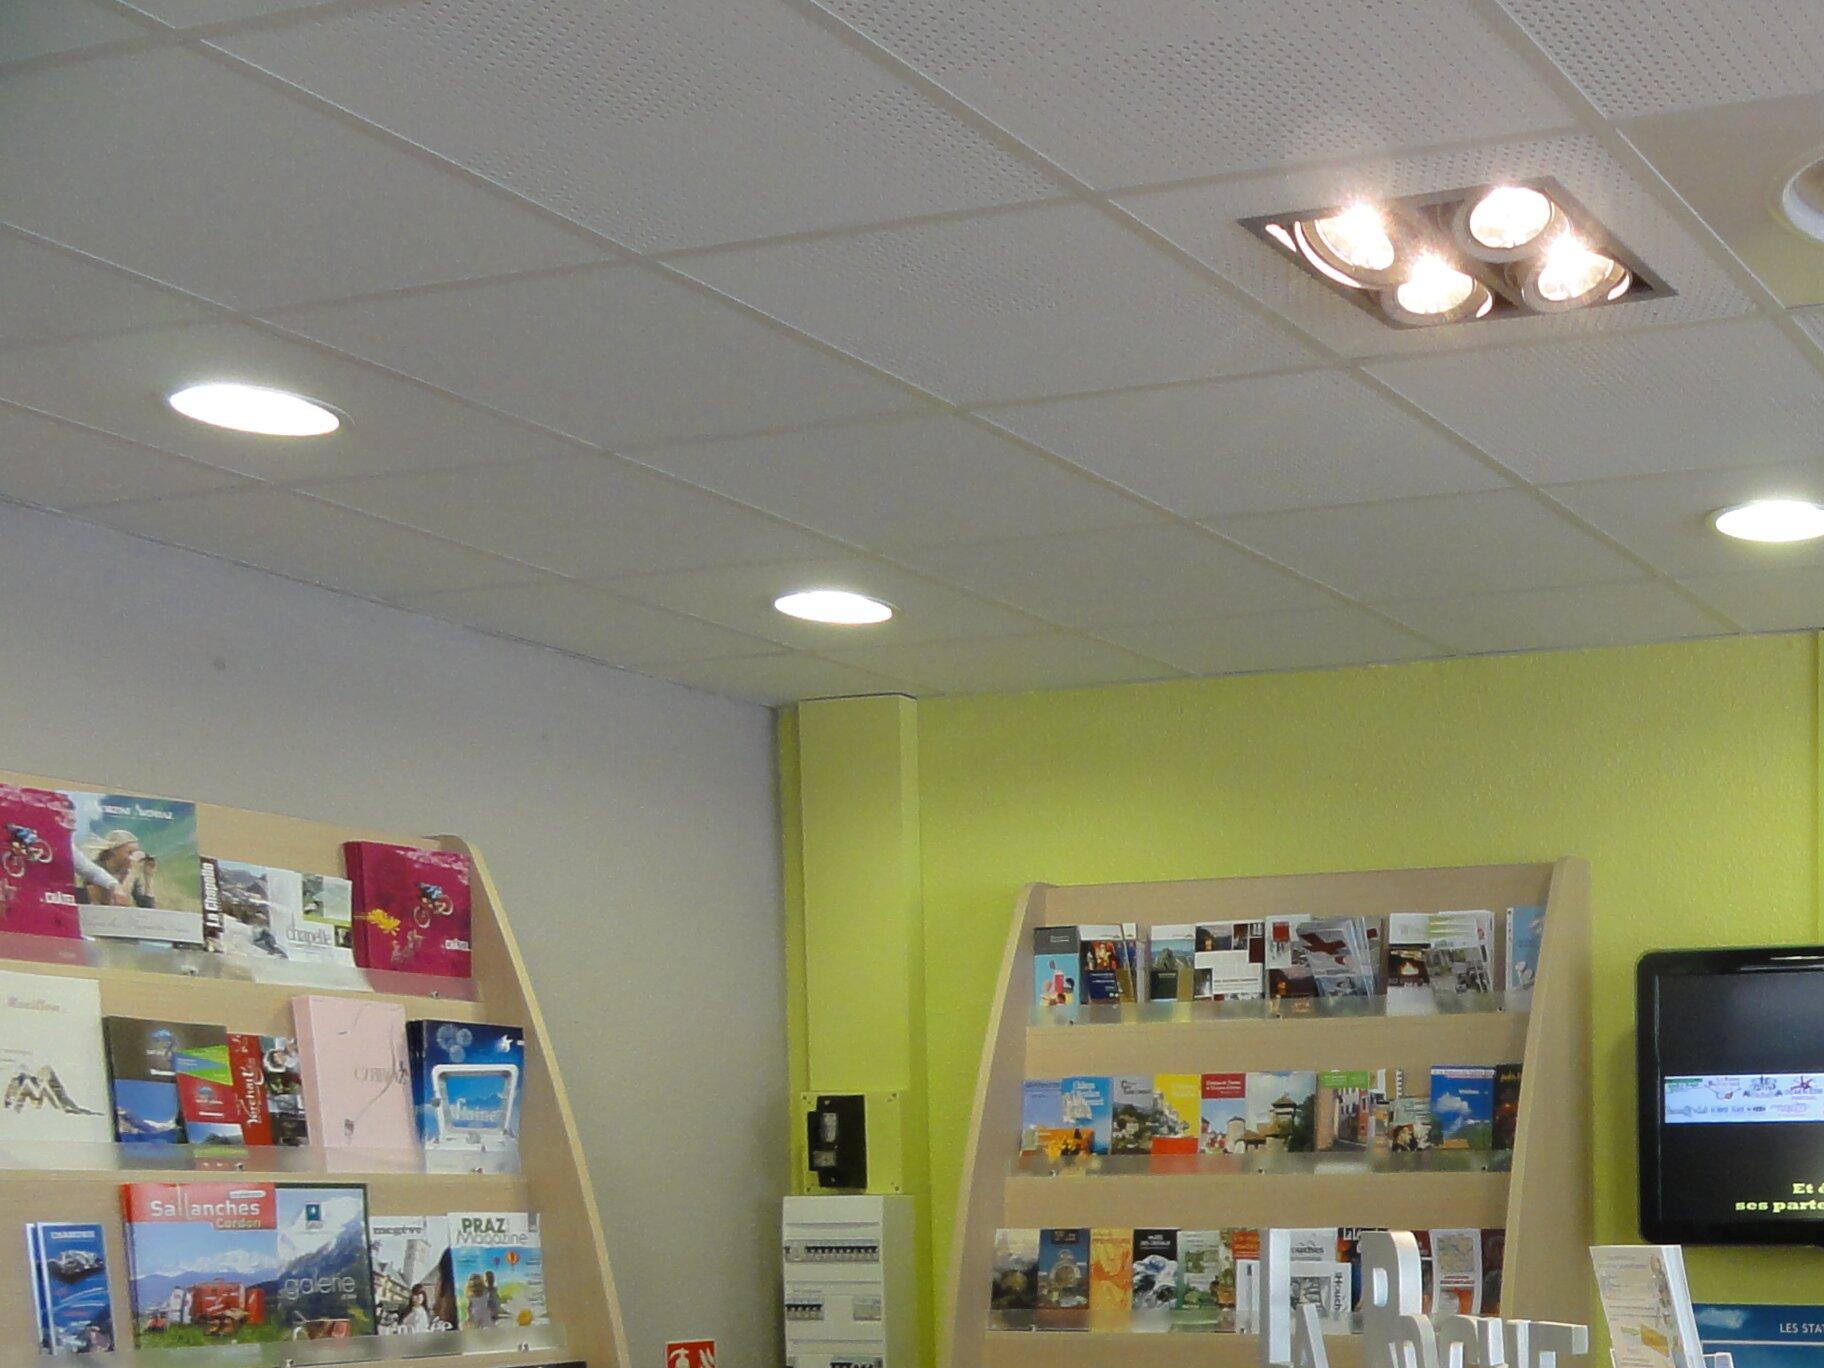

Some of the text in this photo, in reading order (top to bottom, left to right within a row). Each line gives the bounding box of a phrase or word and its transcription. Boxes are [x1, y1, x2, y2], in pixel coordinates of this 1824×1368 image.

[1792, 1182, 1814, 1195] Et
[150, 1184, 261, 1220] Sallanches
[1735, 1201, 1768, 1211] ses
[215, 1218, 261, 1229] Cordon
[461, 1218, 506, 1233] PRAZ
[456, 1230, 529, 1245] Magazine
[1780, 1323, 1799, 1333] LES
